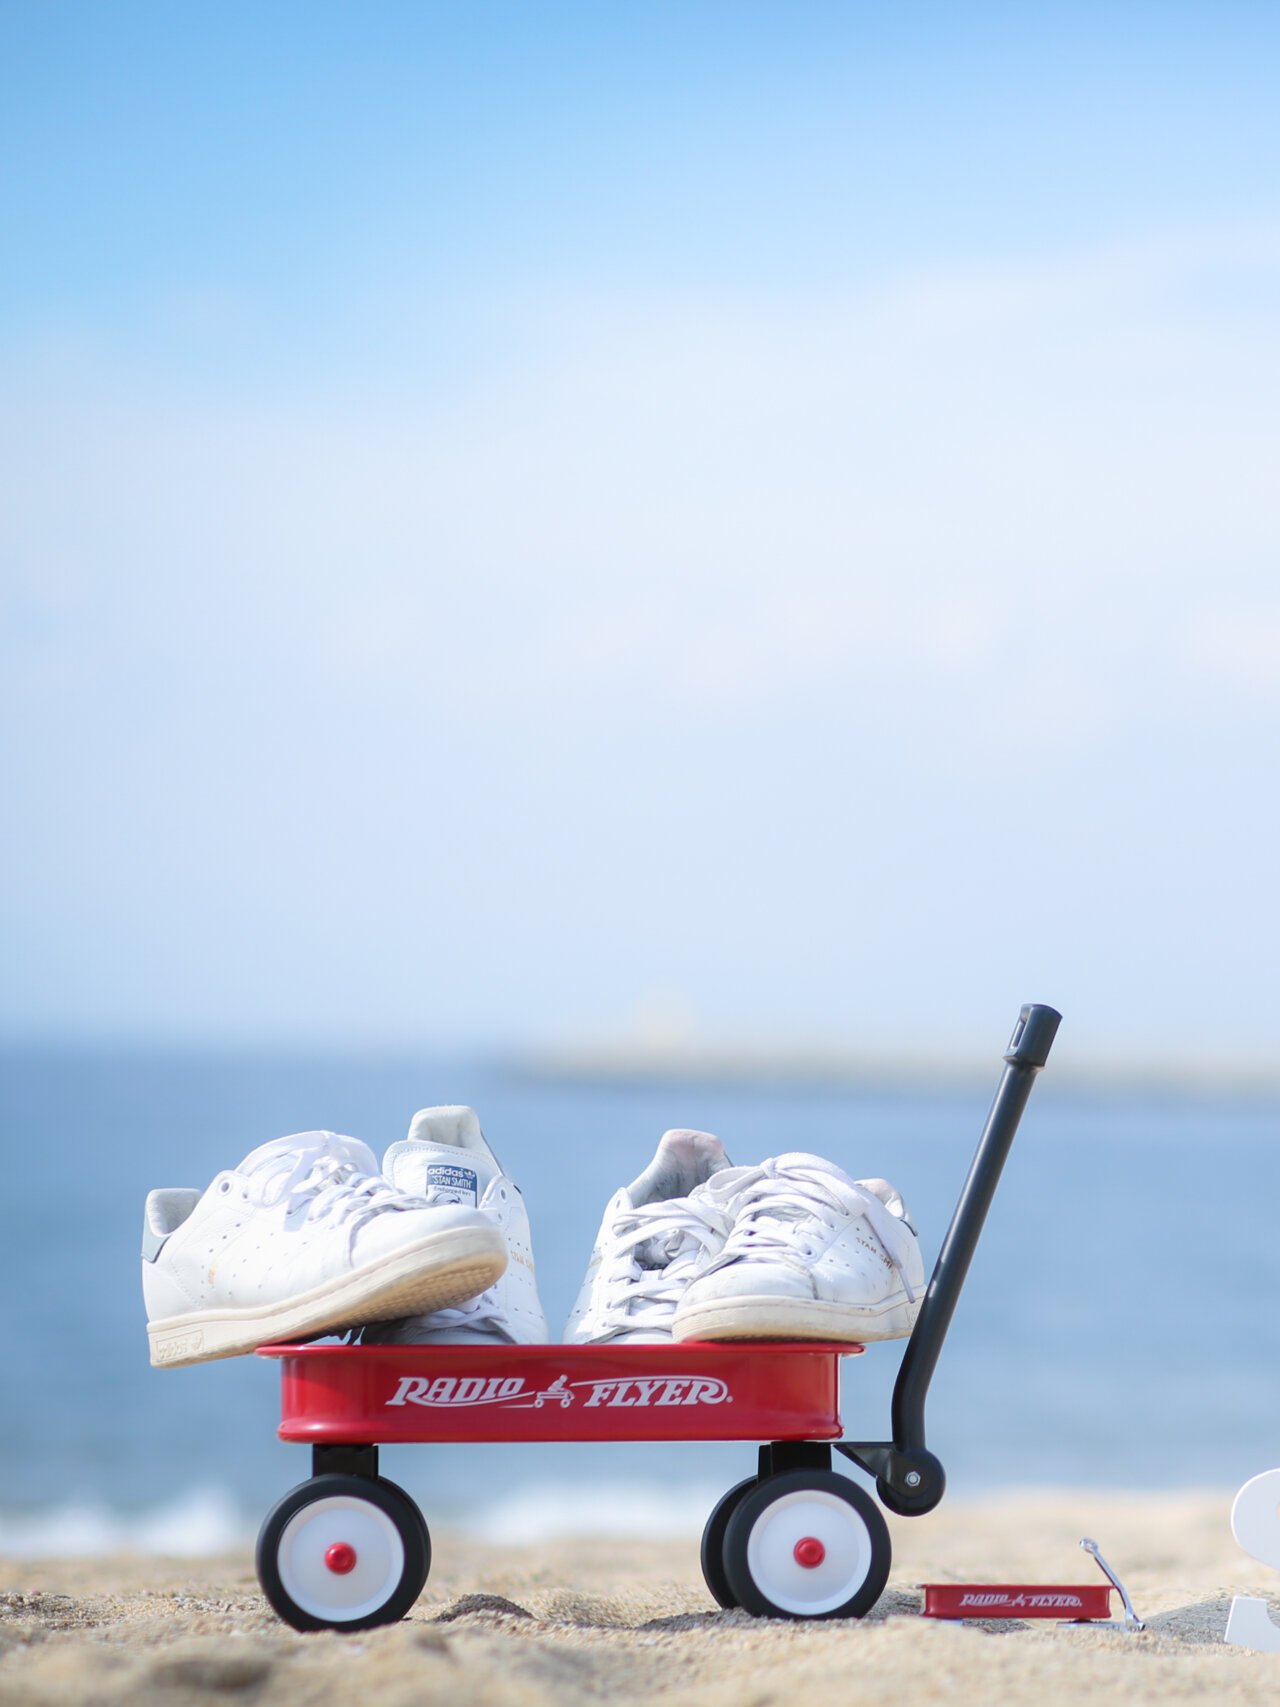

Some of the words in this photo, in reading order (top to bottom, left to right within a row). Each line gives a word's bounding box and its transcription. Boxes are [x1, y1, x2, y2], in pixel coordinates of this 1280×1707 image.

[428, 1167, 464, 1178] adidas
[384, 1376, 528, 1407] RADIO
[959, 1594, 1009, 1606] RADIO
